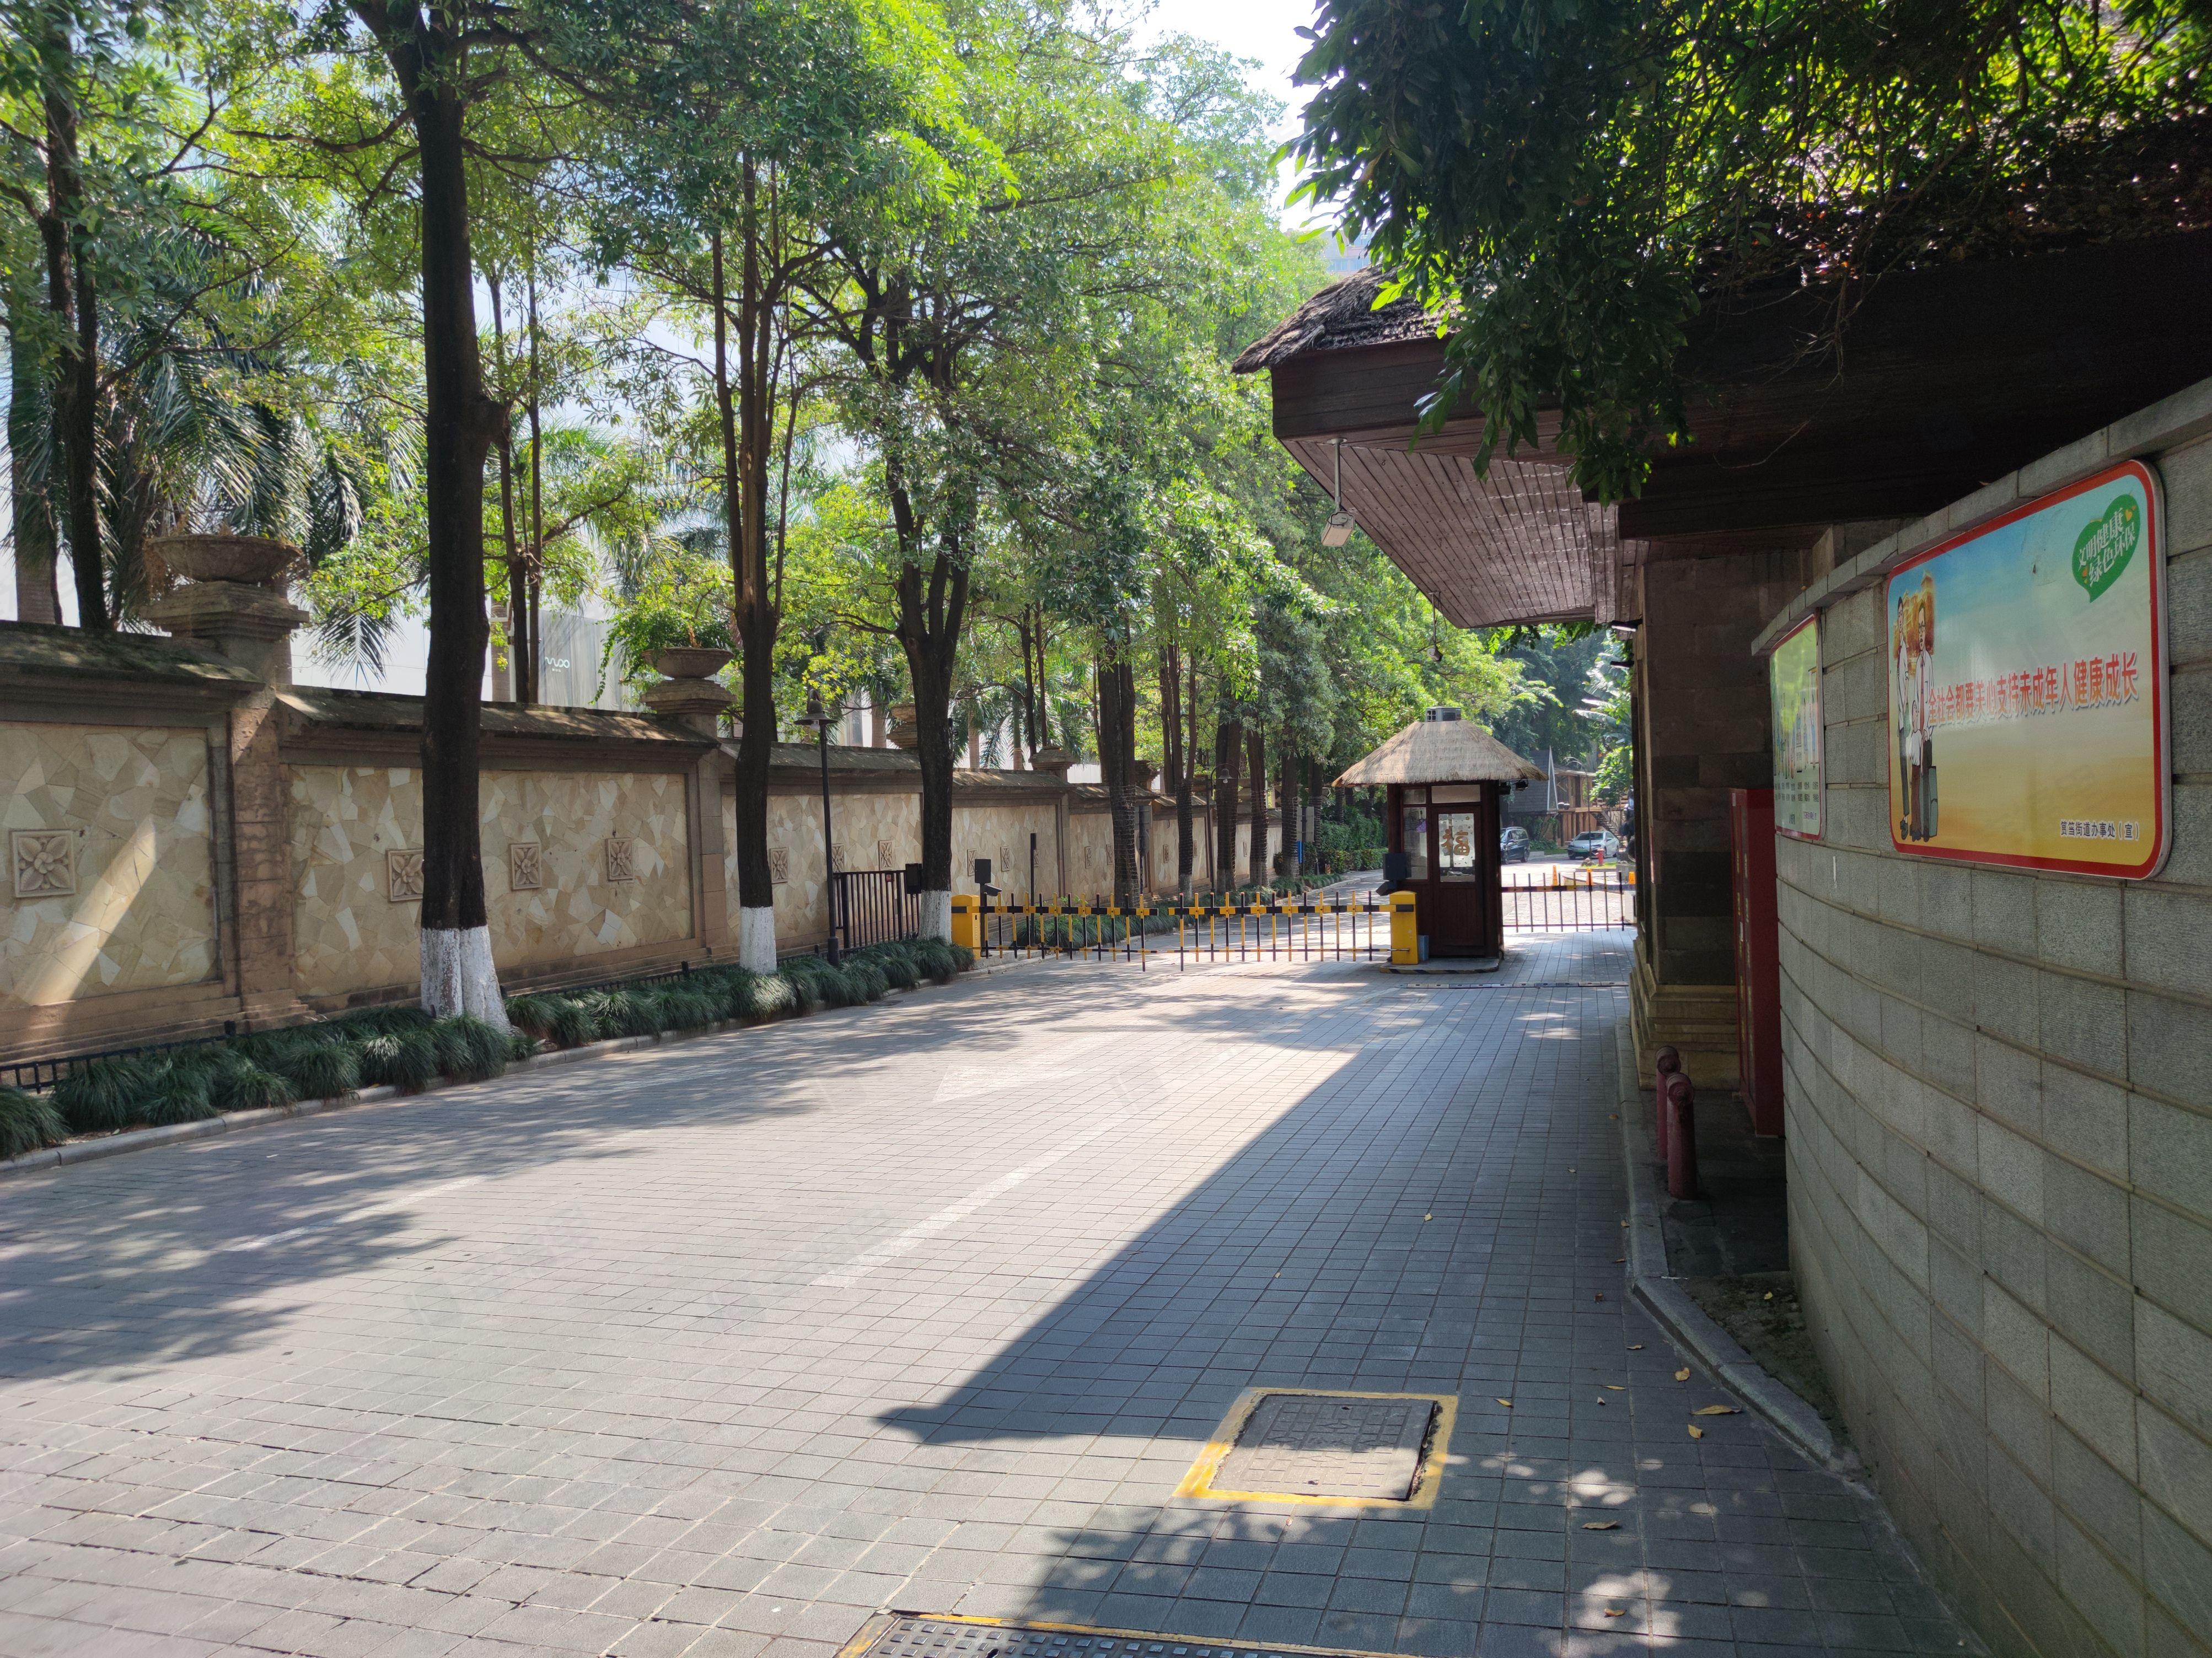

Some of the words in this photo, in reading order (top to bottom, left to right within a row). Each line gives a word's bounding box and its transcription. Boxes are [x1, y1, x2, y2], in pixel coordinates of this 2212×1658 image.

[2077, 508, 2123, 572] 文明健康
[2088, 522, 2136, 588] 绿色环保
[1929, 651, 2138, 725] 全社会都要关心支持未成年人健康成长
[1441, 829, 1470, 857] 福
